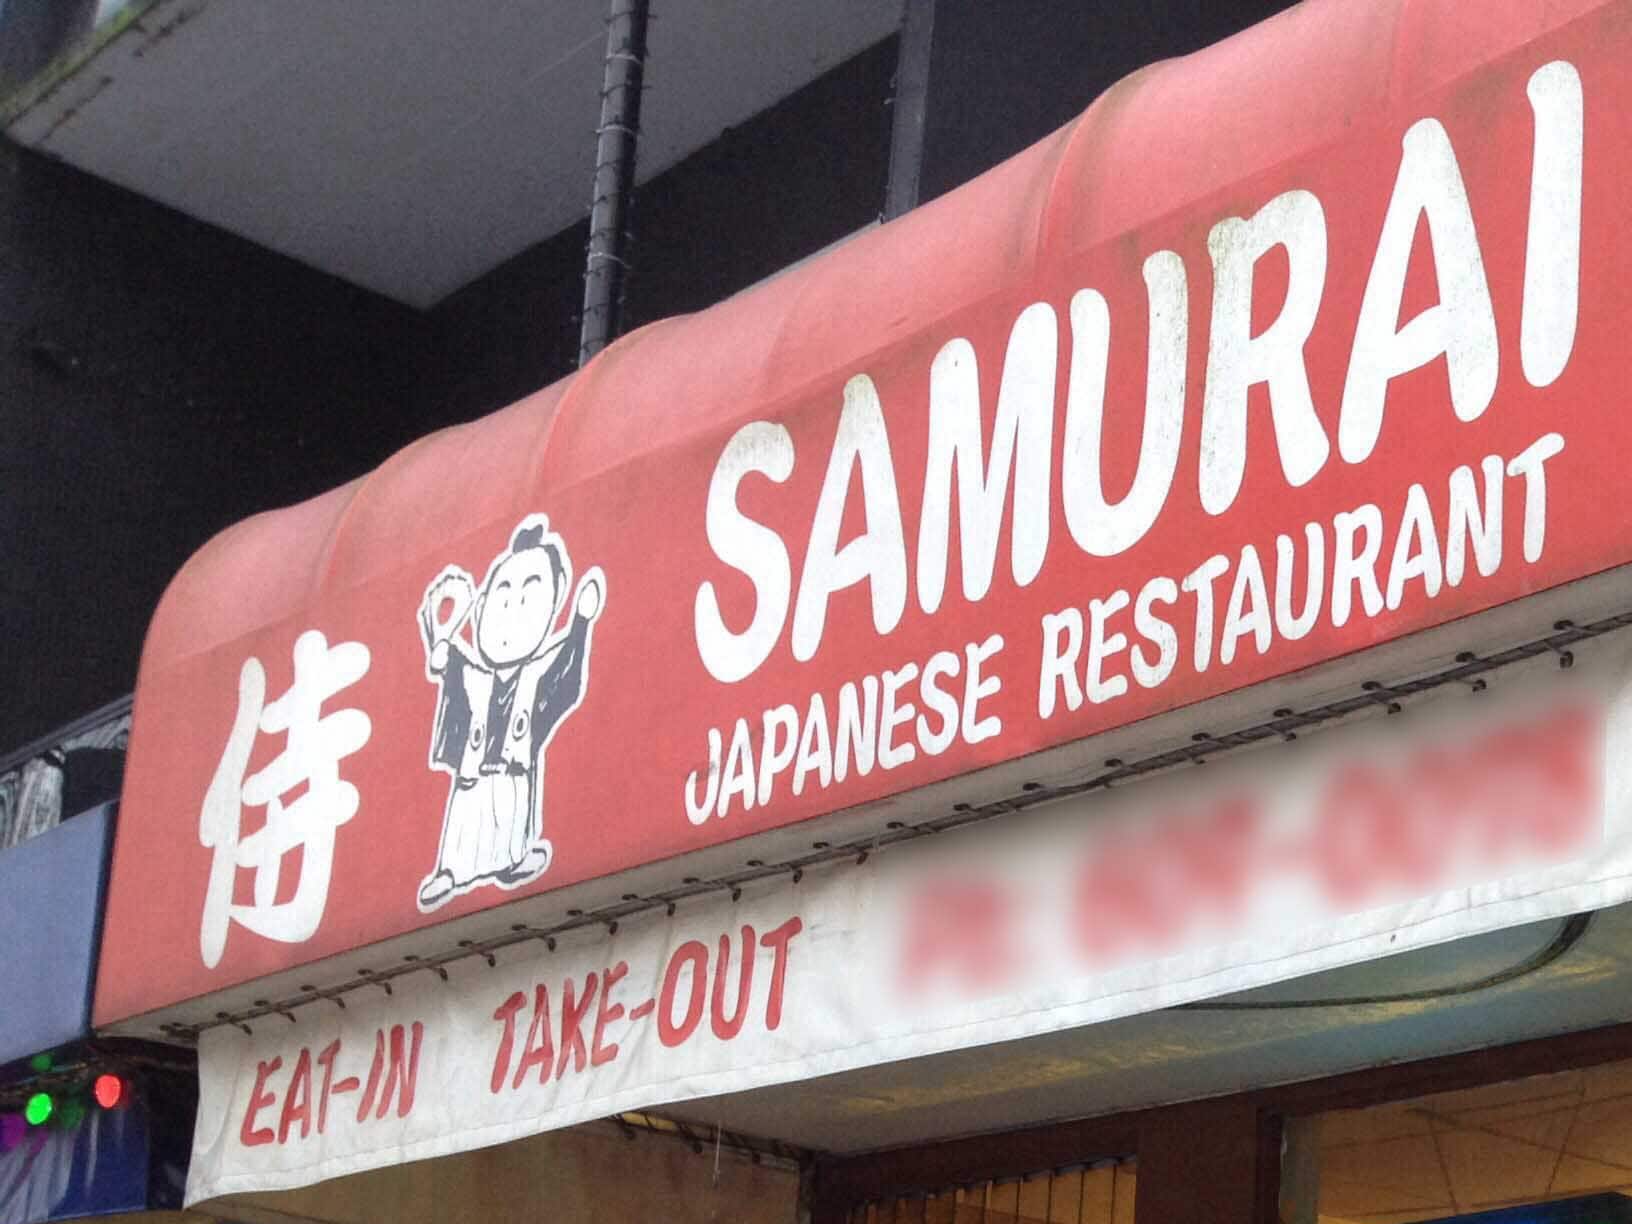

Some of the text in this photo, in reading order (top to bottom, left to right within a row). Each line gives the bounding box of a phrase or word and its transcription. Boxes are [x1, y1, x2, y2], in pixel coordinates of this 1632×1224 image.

[694, 60, 1584, 684] SAMURAI
[200, 629, 371, 969] 侍
[685, 433, 1565, 825] JAPANESE RESTAURANT
[240, 917, 802, 1147] EAT-IN TAKE-OUT
